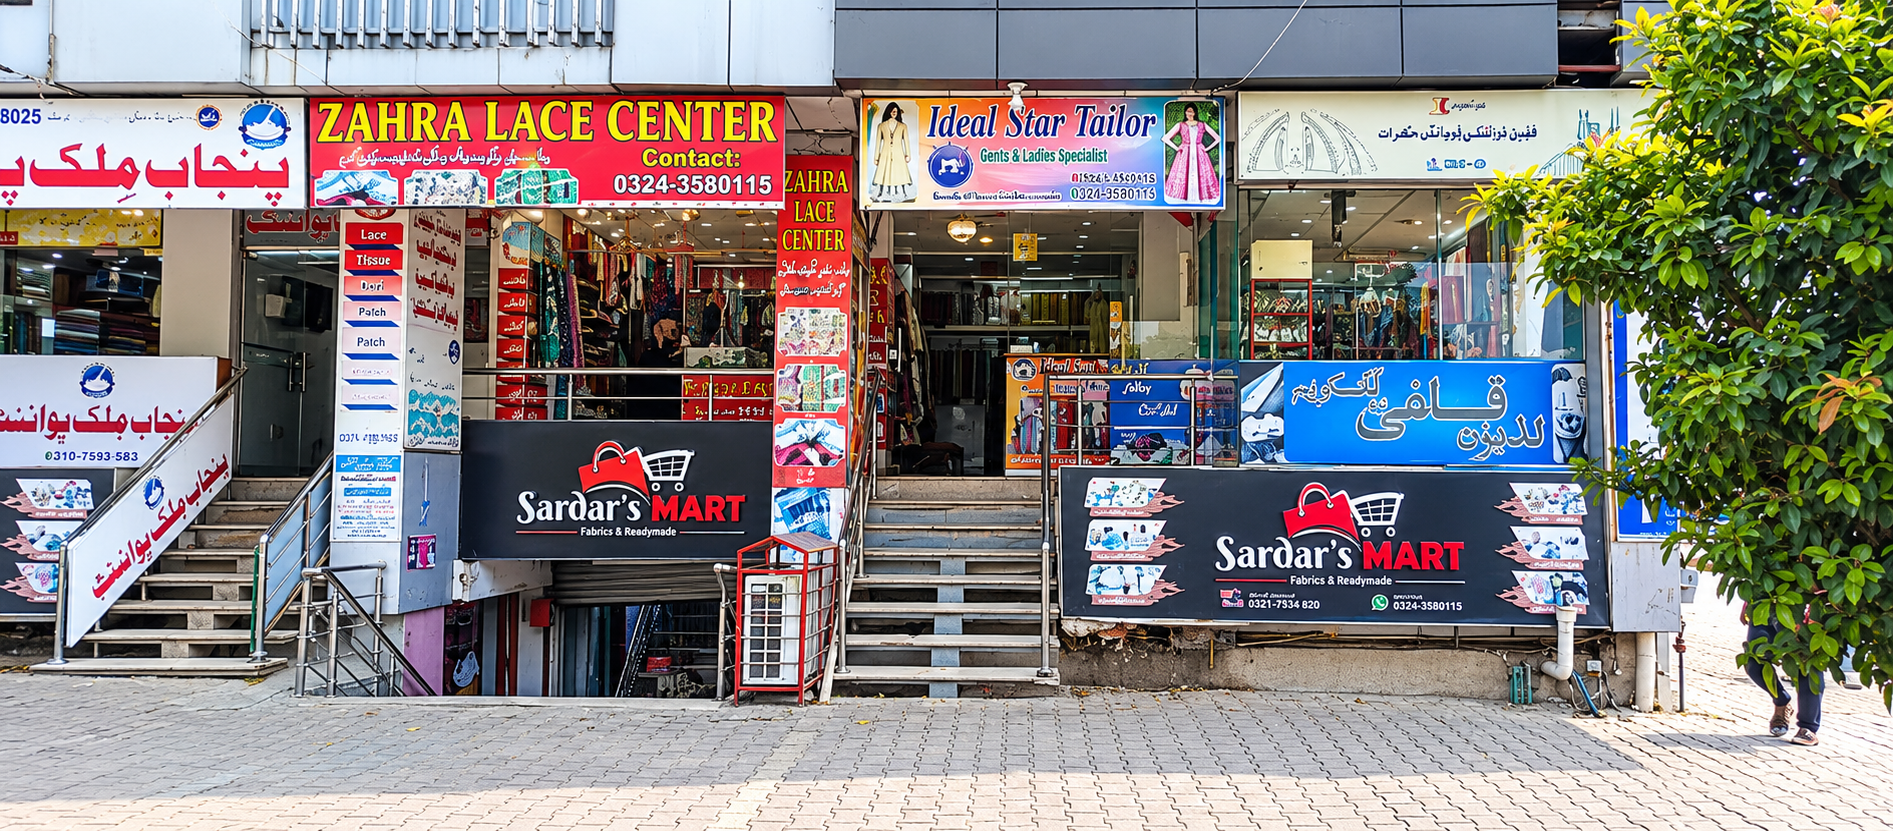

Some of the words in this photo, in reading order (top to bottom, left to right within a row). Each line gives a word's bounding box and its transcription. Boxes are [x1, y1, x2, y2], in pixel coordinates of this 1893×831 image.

[0, 108, 41, 125] 8025
[316, 101, 473, 143] ZAHRA
[484, 100, 594, 142] LACE
[606, 99, 778, 142] CENTER
[927, 104, 997, 138] Ideal
[1005, 105, 1066, 138] Star
[1075, 104, 1157, 138] Tailor
[641, 148, 741, 168] Contact:
[980, 149, 1010, 162] Gents
[1012, 149, 1020, 162] &
[1022, 149, 1056, 162] Ladies
[1058, 149, 1108, 165] Specialist
[145, 143, 289, 206] پنجاب
[613, 174, 773, 195] 0324-3580115
[784, 170, 849, 193] ZAHRA
[794, 200, 836, 222] LACE
[361, 229, 387, 240] Lace
[782, 228, 845, 251] CENTER
[358, 307, 386, 317] Patch
[357, 337, 385, 347] Patch
[131, 405, 199, 441] نجاب
[516, 490, 641, 525] Sardar's
[651, 494, 746, 522] MART
[580, 527, 613, 537] Fabrics
[616, 528, 622, 536] &
[625, 527, 677, 539] Readymade
[1215, 536, 1353, 572] Sardar's
[1363, 541, 1465, 571] MART
[1290, 576, 1325, 585] Fabrics
[1328, 576, 1334, 585] &
[1337, 576, 1392, 587] Readymade
